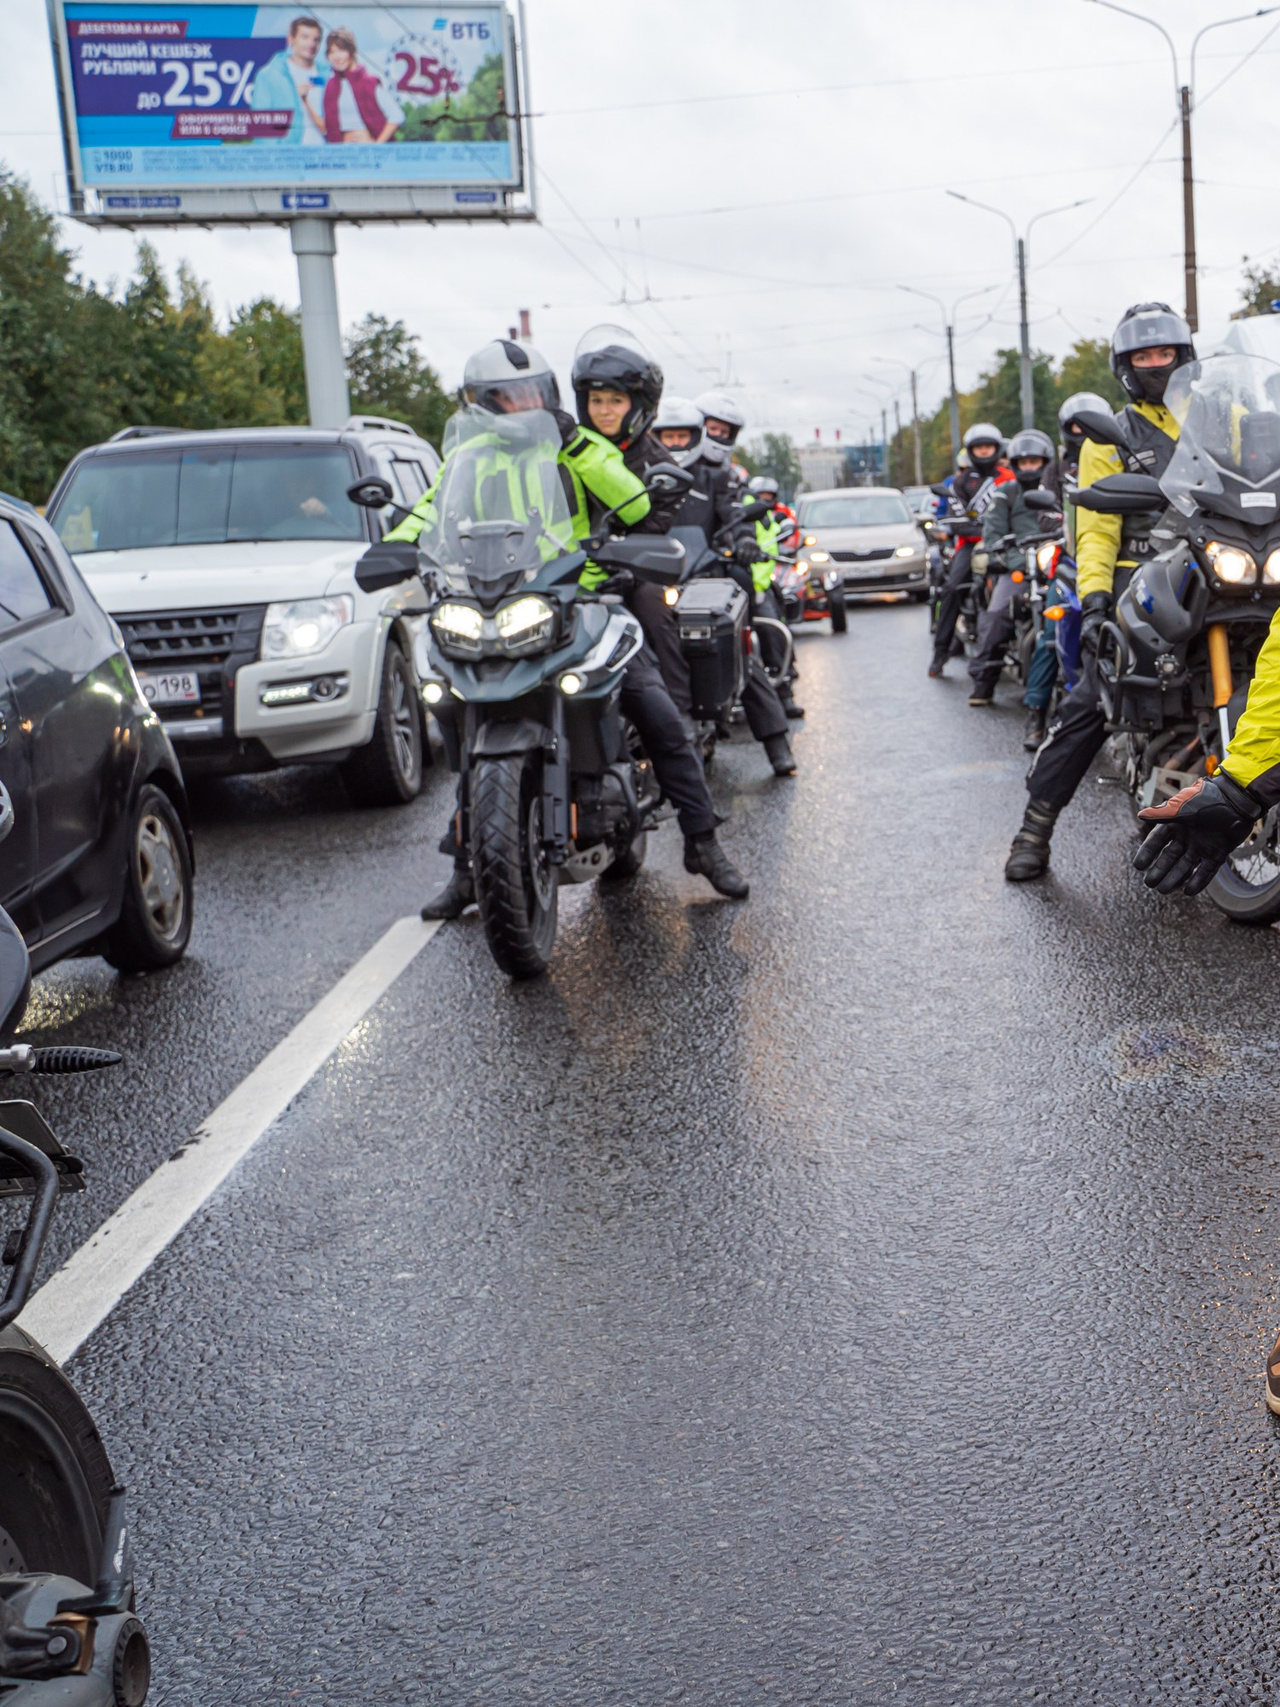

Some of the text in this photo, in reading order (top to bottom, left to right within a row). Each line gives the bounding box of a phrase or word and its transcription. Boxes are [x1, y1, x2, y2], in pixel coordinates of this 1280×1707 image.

[78, 23, 180, 35] ДЕБЕТОВАЯ КАРТА
[451, 21, 490, 40] ВТБ
[81, 40, 213, 59] ЛУЧШИЙ КЕШБЭК
[82, 60, 156, 75] РУБЛЯМИ
[395, 52, 460, 97] 25%
[162, 60, 256, 107] 25%
[160, 675, 192, 695] 198
